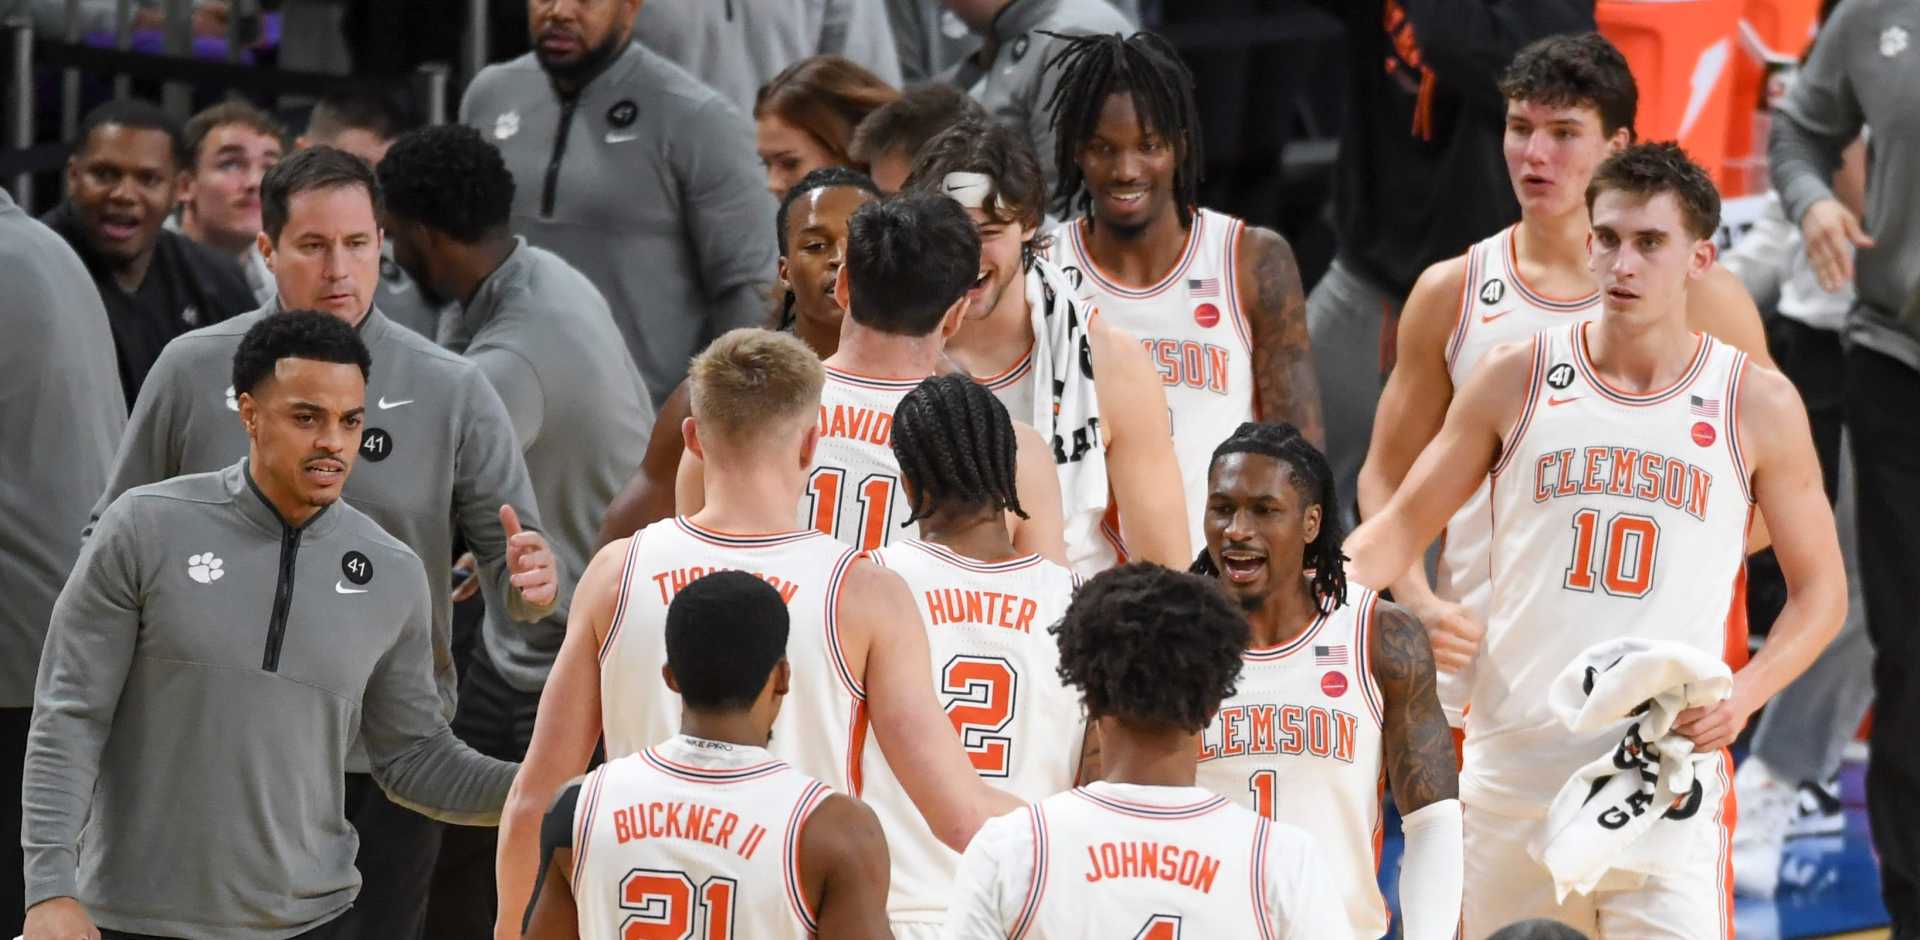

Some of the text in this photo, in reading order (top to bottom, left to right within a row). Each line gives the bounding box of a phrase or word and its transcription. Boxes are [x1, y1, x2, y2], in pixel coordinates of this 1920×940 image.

[1481, 280, 1501, 302] 41
[1548, 366, 1572, 386] 41
[363, 434, 384, 453] 41
[818, 404, 894, 449] DAVID
[806, 466, 897, 552] 11
[1534, 446, 1713, 522] CLEMSON
[347, 557, 366, 577] 41
[1563, 507, 1662, 600] 10
[925, 588, 1037, 635] HUNTER
[941, 654, 1018, 778] 2
[1248, 769, 1278, 822] 1
[613, 801, 767, 861] BUCKNER II
[1085, 841, 1221, 895] JOHNSON
[618, 867, 738, 940] 21
